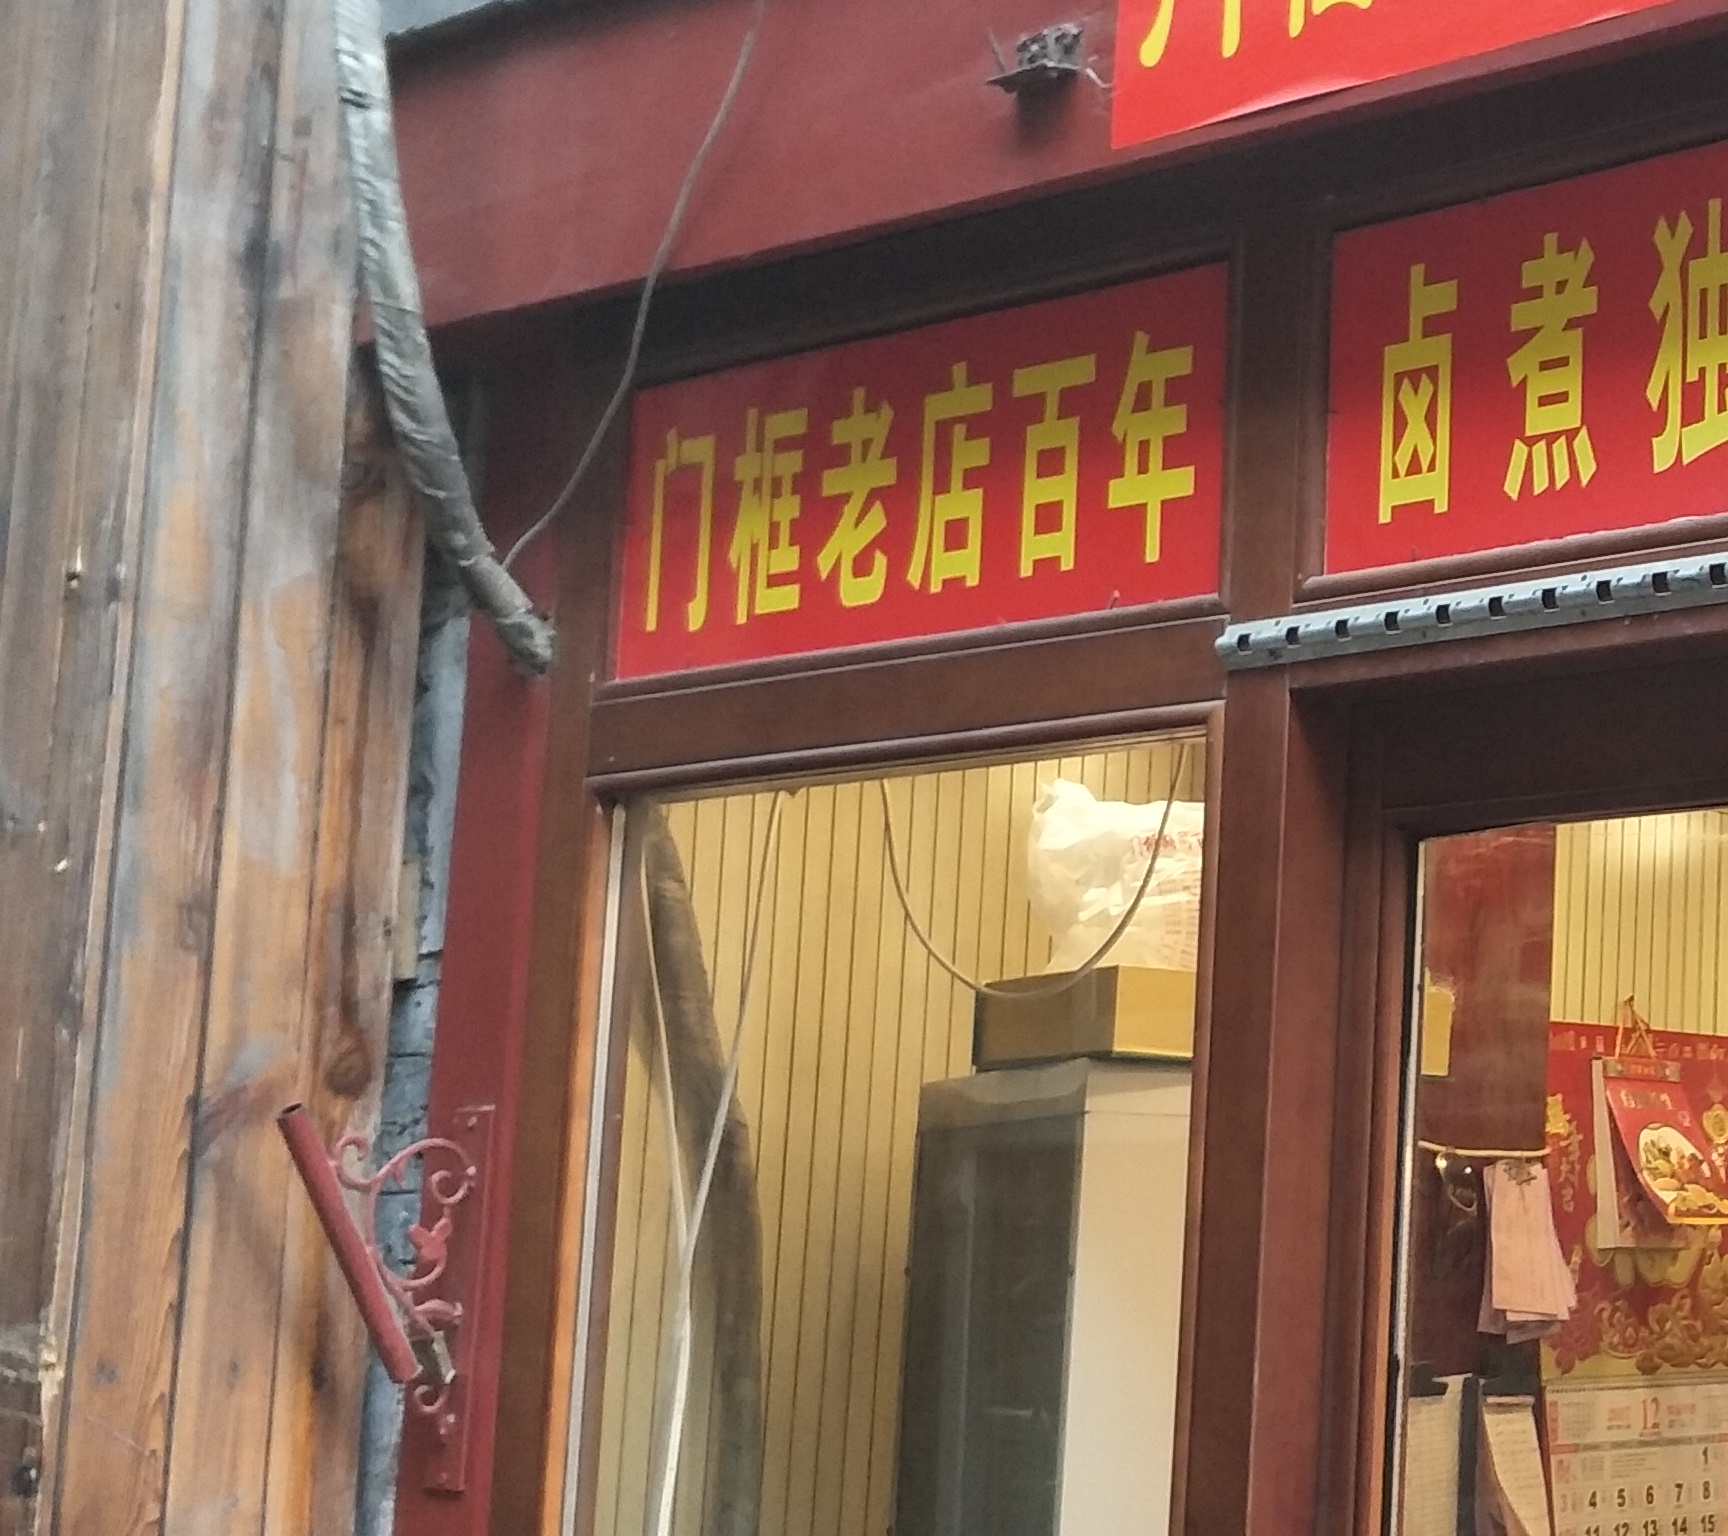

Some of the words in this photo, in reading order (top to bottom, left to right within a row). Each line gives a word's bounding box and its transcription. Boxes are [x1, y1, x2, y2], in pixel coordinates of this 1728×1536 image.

[645, 329, 1195, 632] 门框老店百年
[1588, 1490, 1598, 1509] 4
[1616, 1488, 1626, 1508] 5
[1645, 1485, 1654, 1505] 6
[1675, 1482, 1684, 1502] 7
[1702, 1480, 1711, 1500] 8
[1671, 1516, 1688, 1536] 14
[1700, 1514, 1715, 1534] 15
